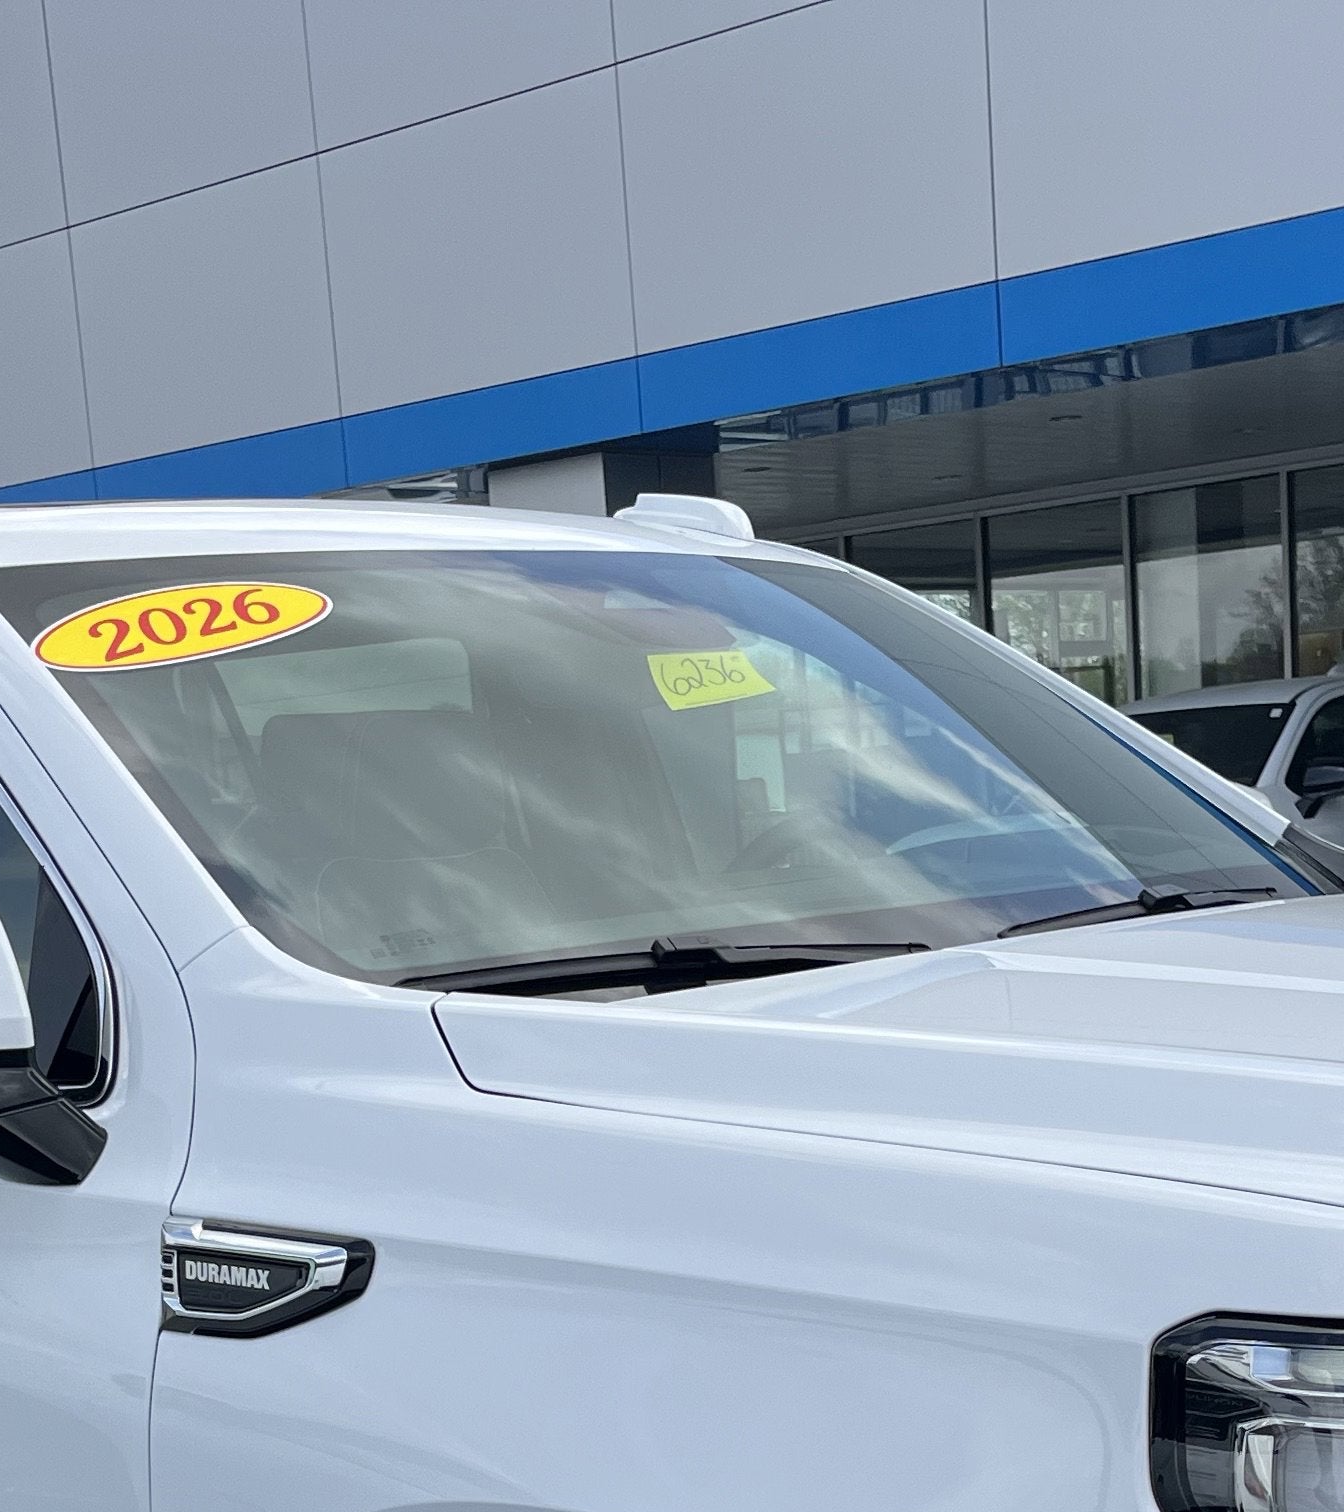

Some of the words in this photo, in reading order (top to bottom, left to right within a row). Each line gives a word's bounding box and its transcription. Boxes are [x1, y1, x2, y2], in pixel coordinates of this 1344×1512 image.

[88, 588, 280, 662] 2026
[660, 654, 746, 696] 6236
[184, 1259, 271, 1291] DURAMAX
